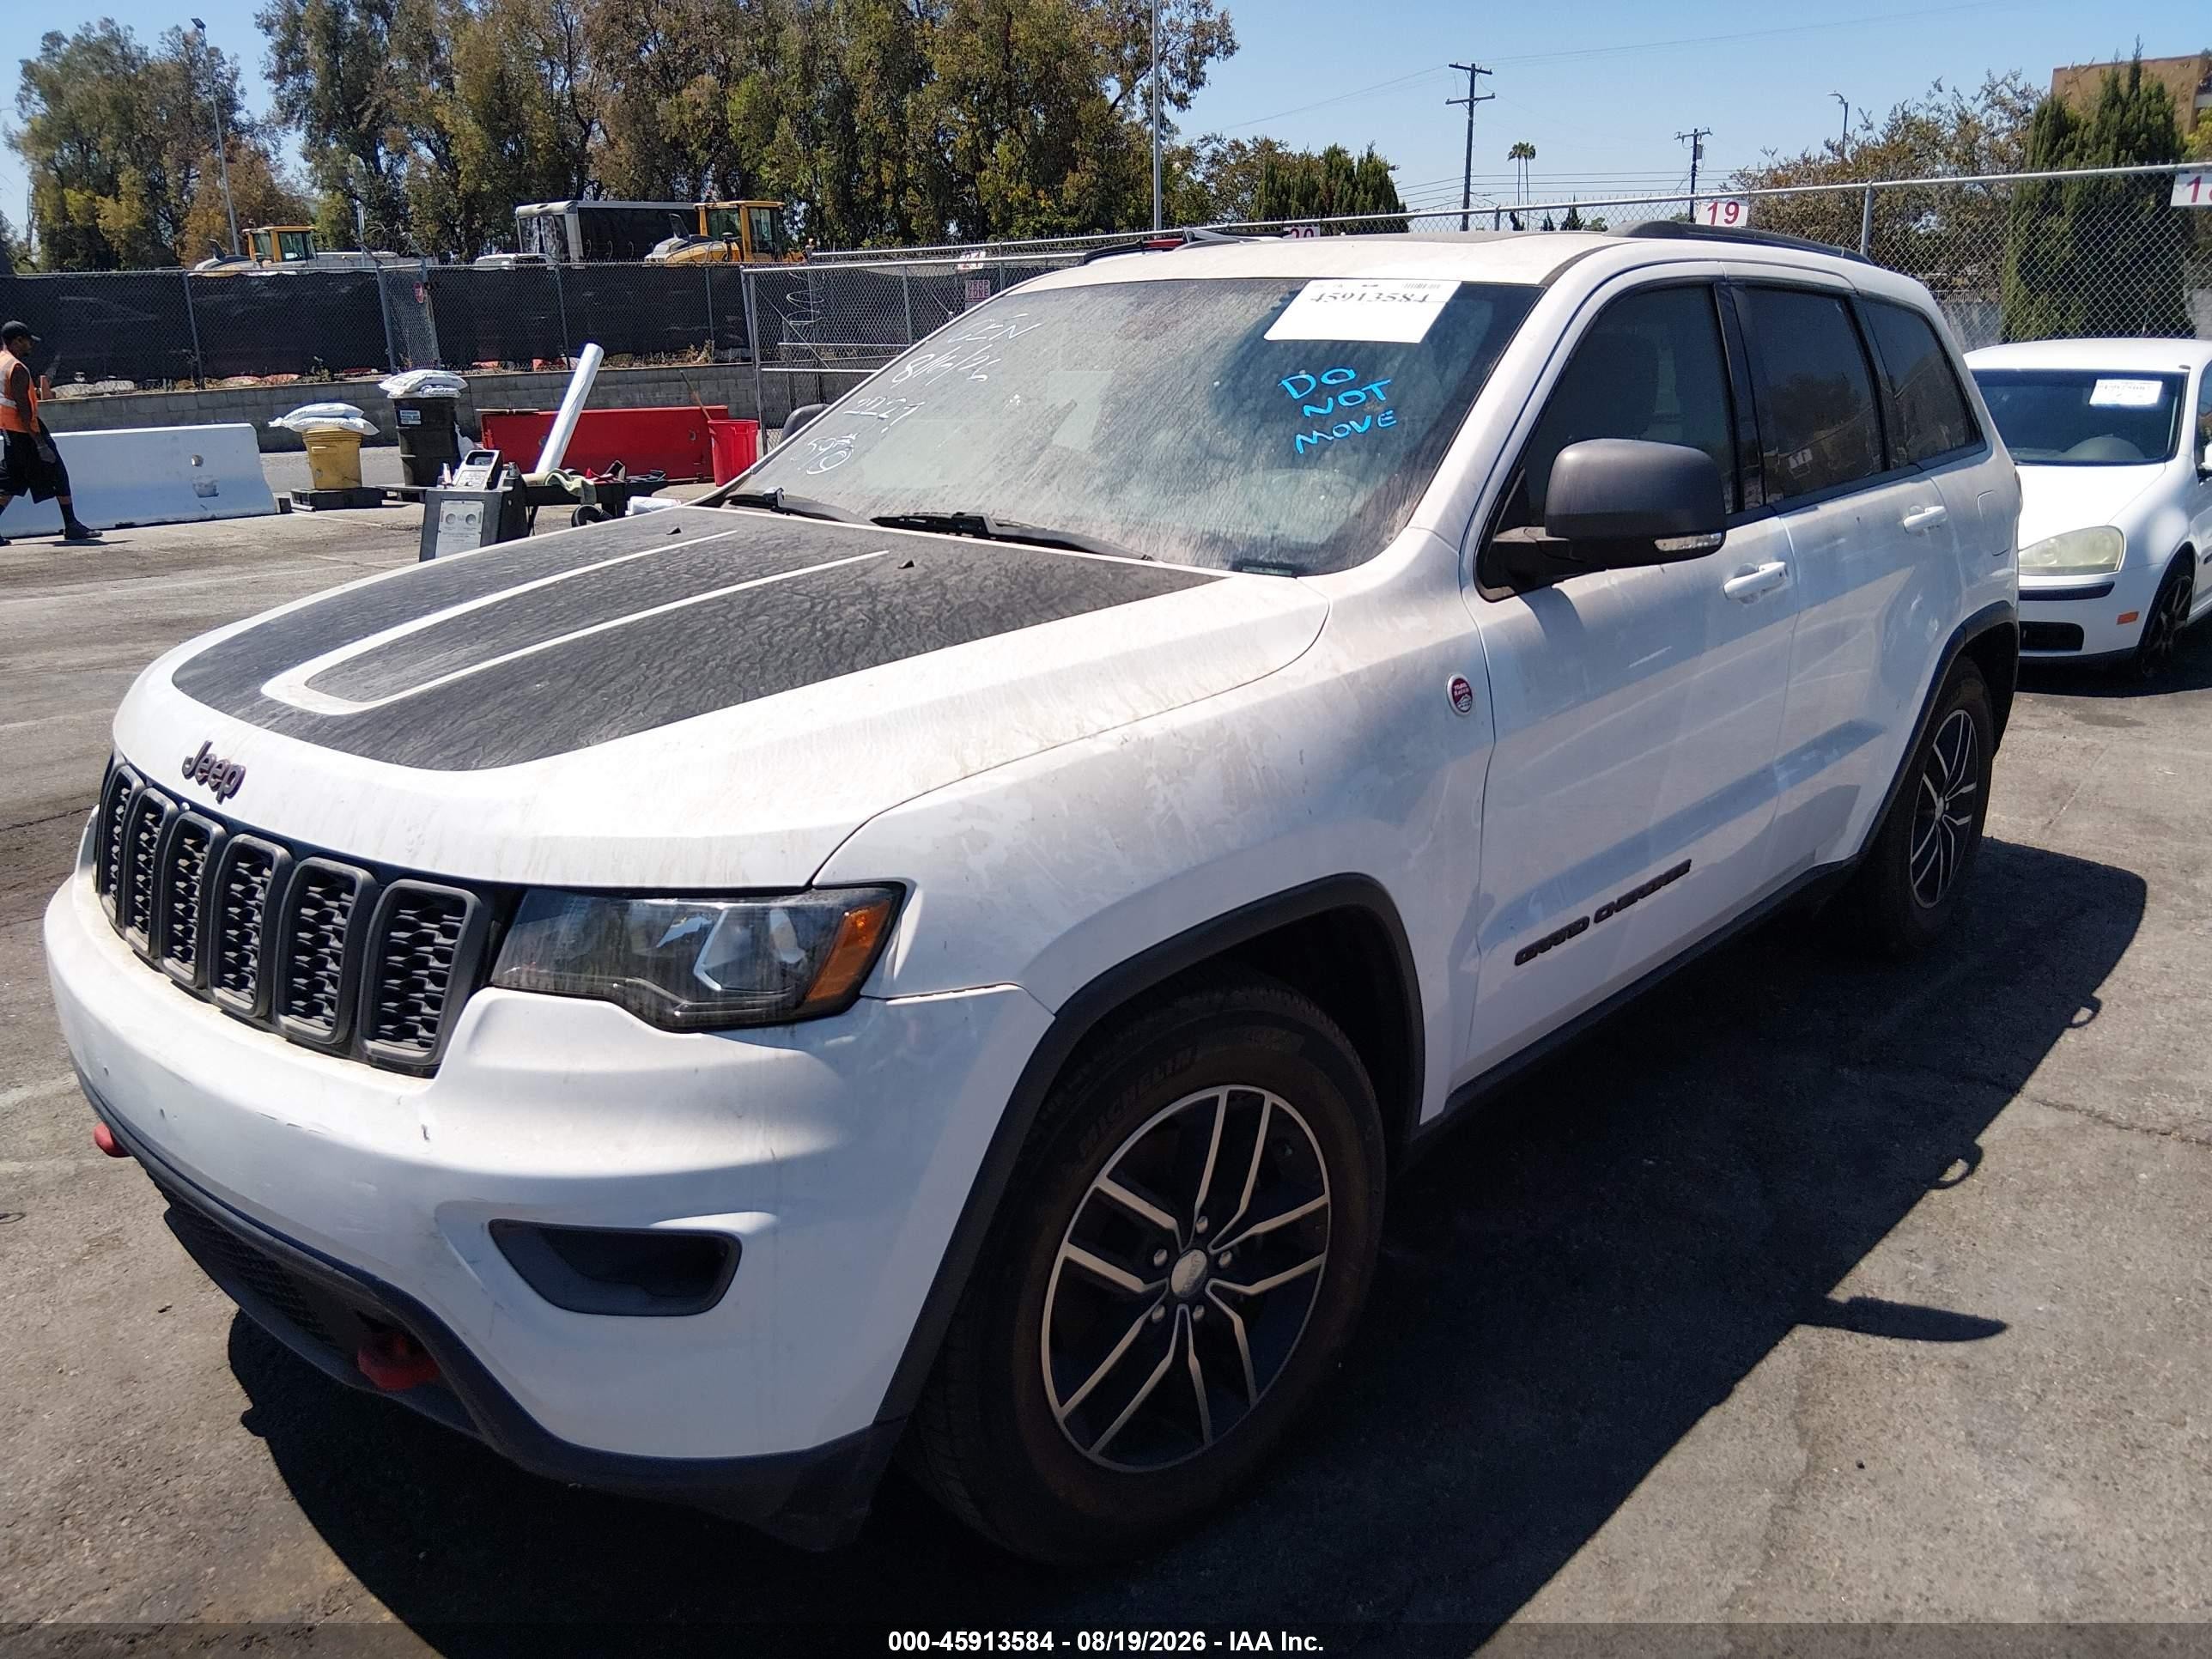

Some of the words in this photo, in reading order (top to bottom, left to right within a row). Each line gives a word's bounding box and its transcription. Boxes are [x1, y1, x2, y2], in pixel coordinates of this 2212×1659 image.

[2186, 175, 2212, 204] 1
[1707, 201, 1740, 226] 19
[967, 280, 989, 289] DROP
[967, 289, 990, 297] ZONE
[1310, 292, 1431, 303] 45913584
[1277, 368, 1357, 400] DO
[1303, 379, 1392, 418] NOT
[1294, 410, 1397, 454] MOVE
[181, 739, 246, 805] Jeep
